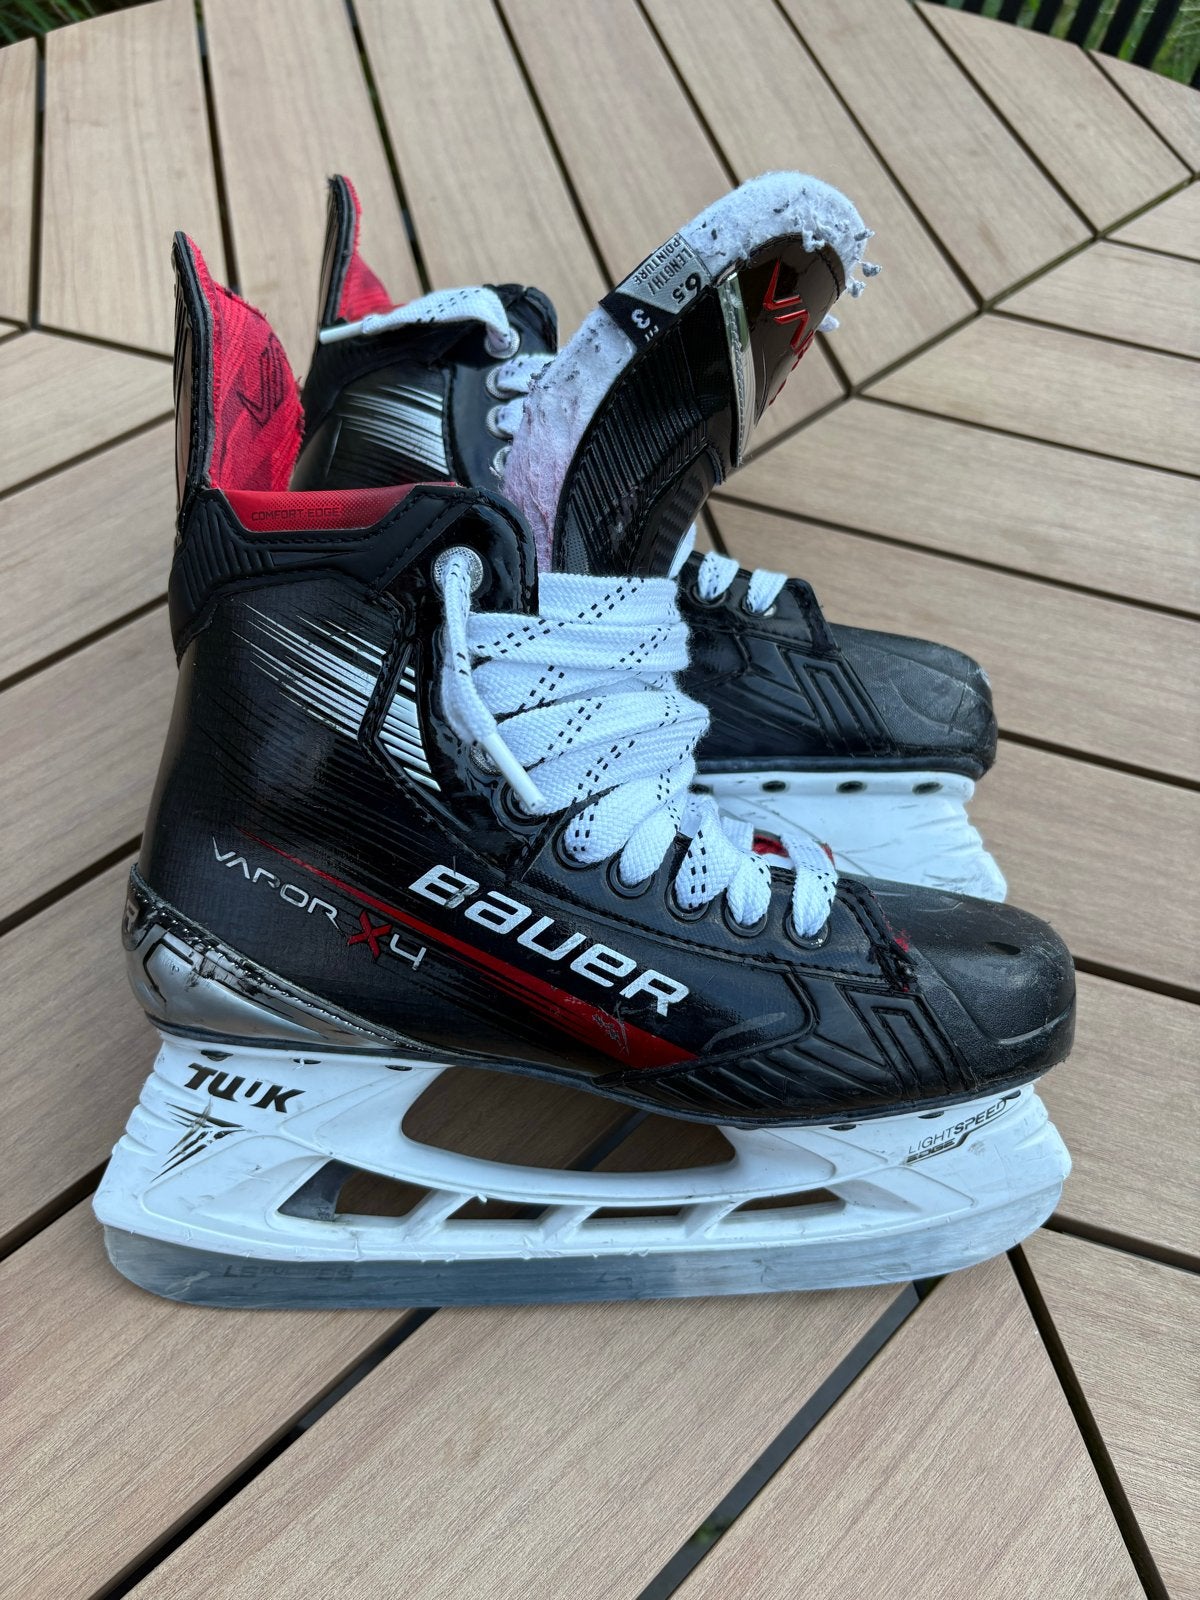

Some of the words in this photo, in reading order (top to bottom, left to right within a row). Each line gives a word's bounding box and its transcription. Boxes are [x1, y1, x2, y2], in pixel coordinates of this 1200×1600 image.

[633, 238, 680, 285] POINTURE
[647, 247, 694, 296] LENGTH/
[672, 272, 702, 304] 6.5
[631, 308, 651, 329] 3
[251, 509, 304, 521] COMFORT
[307, 507, 340, 518] EDGE
[212, 835, 340, 930] VAPOR
[347, 910, 427, 971] X4
[908, 1098, 1008, 1154] LIGHTSPEED
